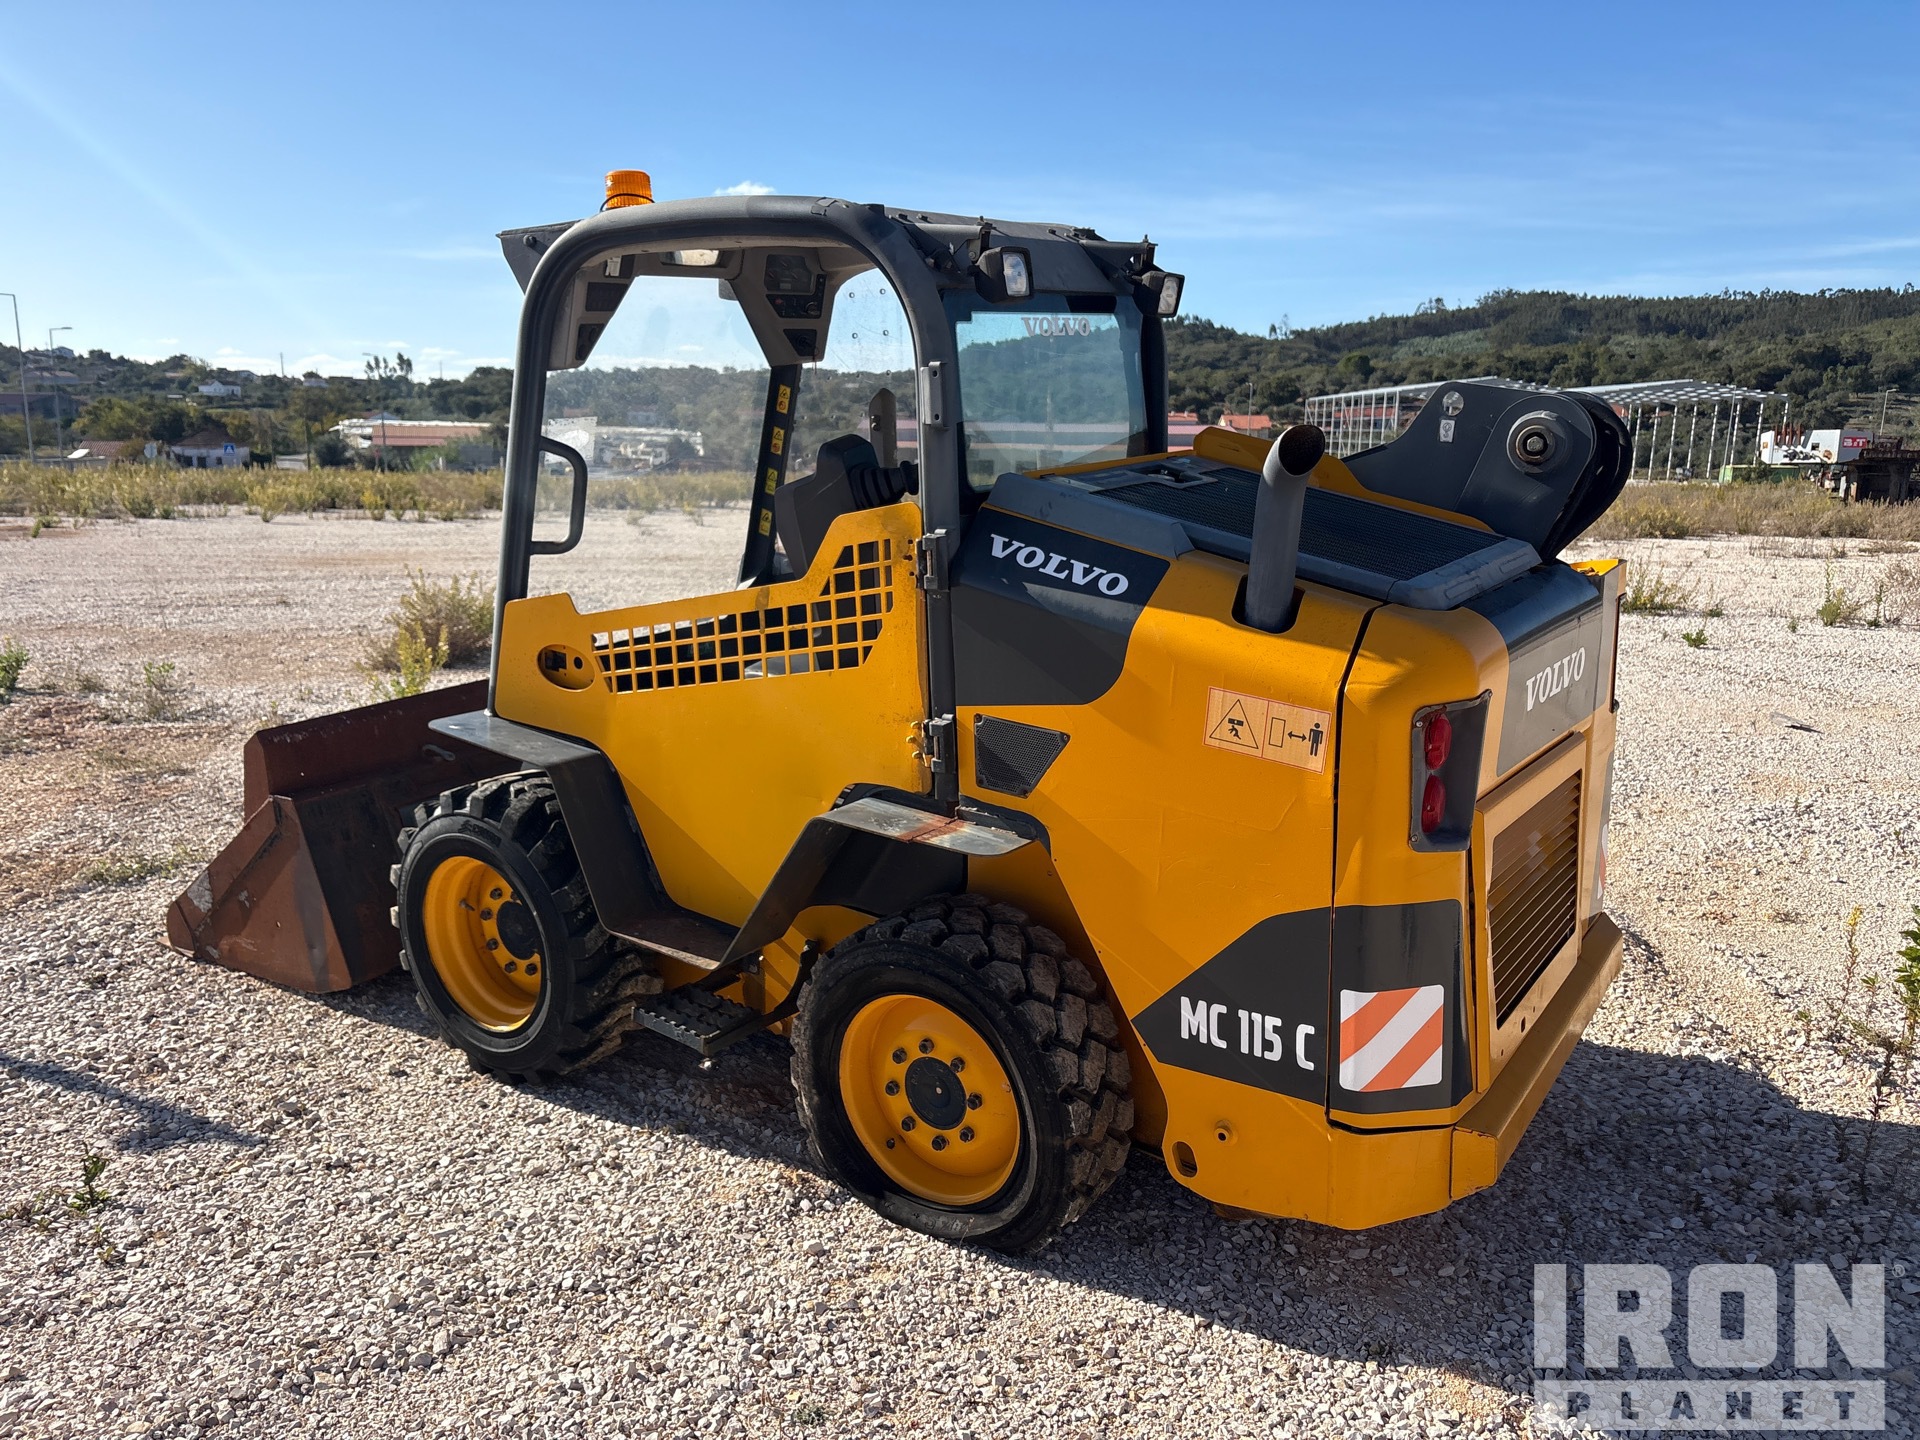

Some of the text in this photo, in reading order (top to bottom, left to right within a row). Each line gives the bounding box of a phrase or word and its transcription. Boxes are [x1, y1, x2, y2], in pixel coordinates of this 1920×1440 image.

[1021, 316, 1091, 337] VOLVO
[990, 533, 1129, 596] VOLVO
[1525, 646, 1586, 712] VOLVO
[1180, 995, 1315, 1071] MC 115 C
